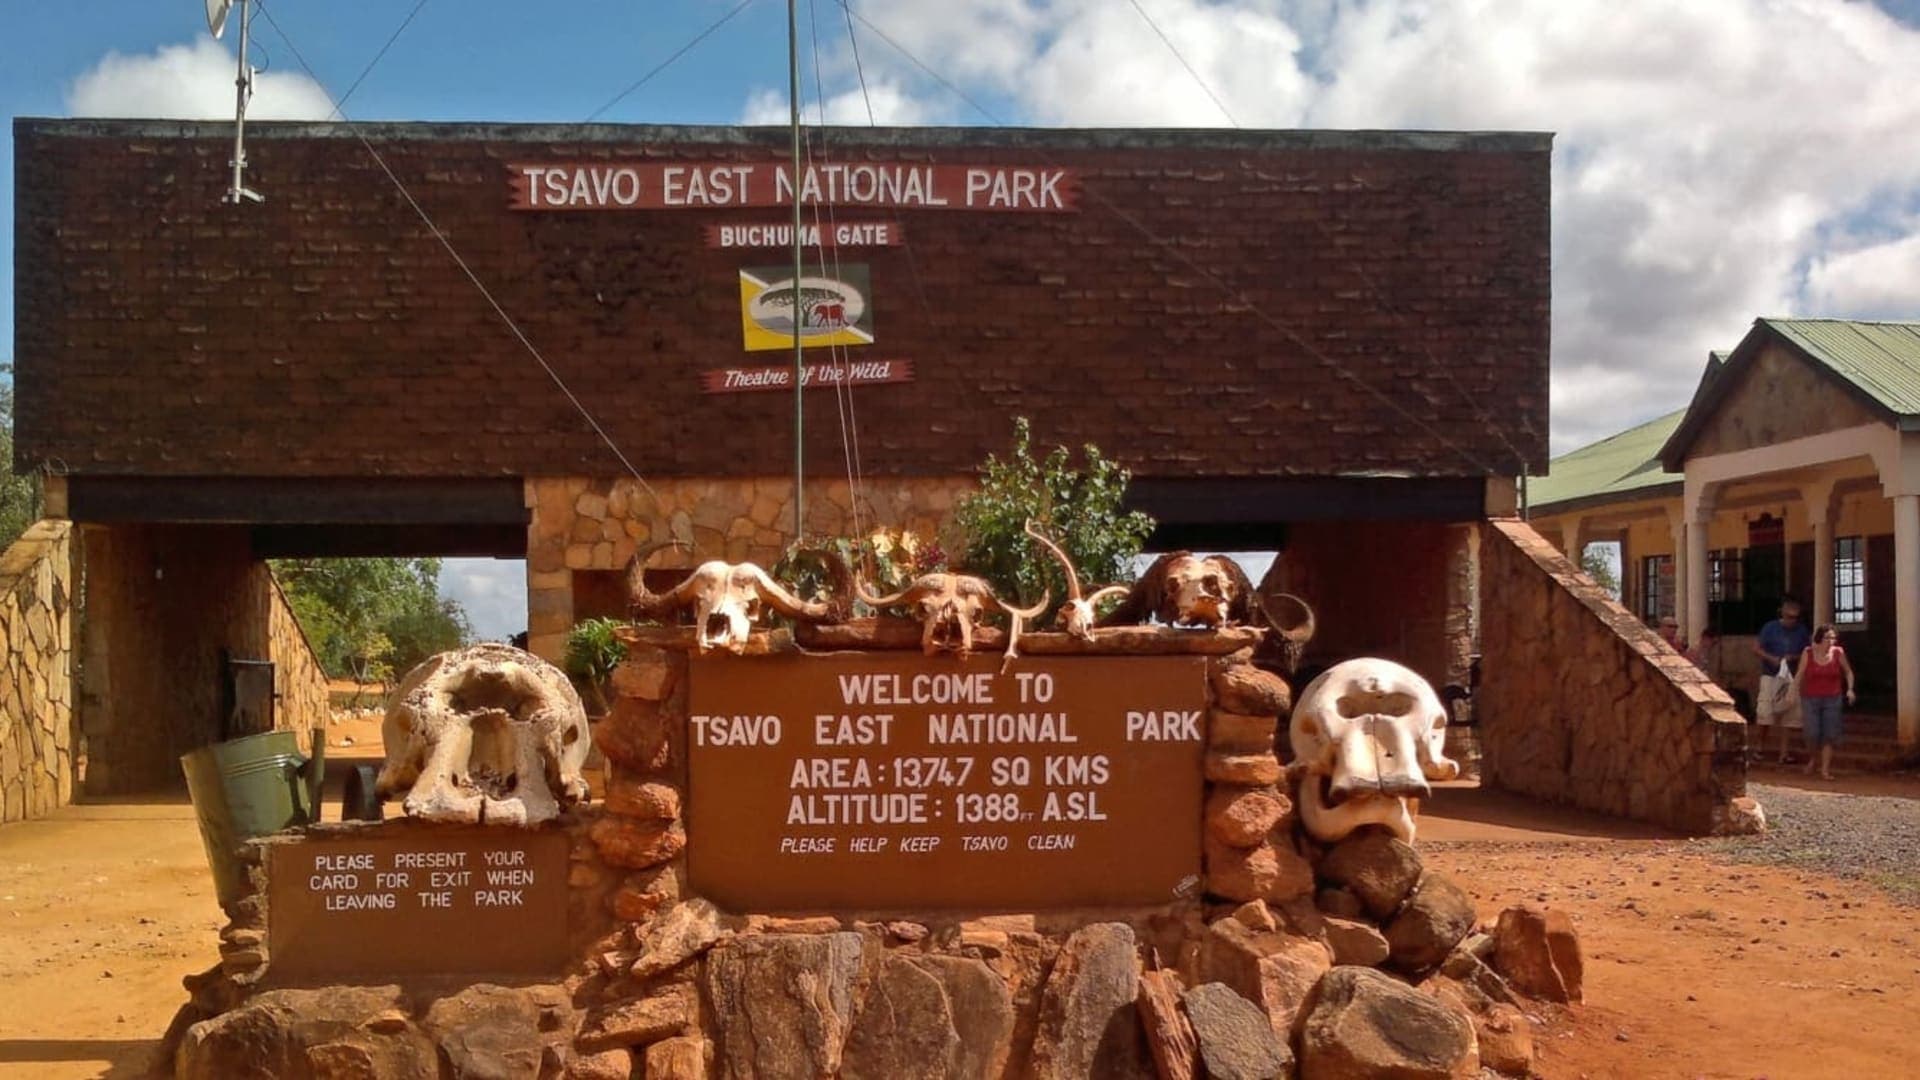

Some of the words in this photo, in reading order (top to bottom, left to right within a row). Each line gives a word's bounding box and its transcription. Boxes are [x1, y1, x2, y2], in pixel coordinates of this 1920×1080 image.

[523, 168, 640, 205] TSAVO
[663, 167, 754, 205] EAST
[775, 166, 948, 206] NATIONAL
[966, 169, 1064, 208] PARK
[720, 225, 820, 247] BUCHUMA
[836, 225, 888, 245] GATE
[724, 369, 789, 388] Theatre
[818, 365, 844, 382] the
[849, 361, 890, 379] Wild
[838, 673, 994, 705] WELCOME
[1015, 672, 1054, 703] TO
[691, 715, 781, 746] TSAVO
[815, 714, 894, 745] EAST
[928, 712, 1078, 744] NATIONAL
[1126, 711, 1202, 741] PARK
[991, 756, 1030, 786] SQ
[1045, 755, 1110, 785] KMS
[780, 837, 836, 854] PLEASE
[850, 837, 888, 853] HELP
[899, 836, 941, 853] KEEP
[962, 836, 1008, 851] TSAVO
[1027, 834, 1075, 850] CLEAN
[315, 854, 374, 871] PLEASE
[395, 852, 466, 868] PRESENT
[484, 850, 525, 866] YOUR
[310, 874, 358, 890] CARD
[376, 872, 409, 889] FOR
[430, 871, 471, 888] EXIT
[486, 869, 534, 886] WHEN
[326, 893, 396, 910] LEAVING
[418, 891, 452, 908] THE
[475, 889, 523, 906] PARK
